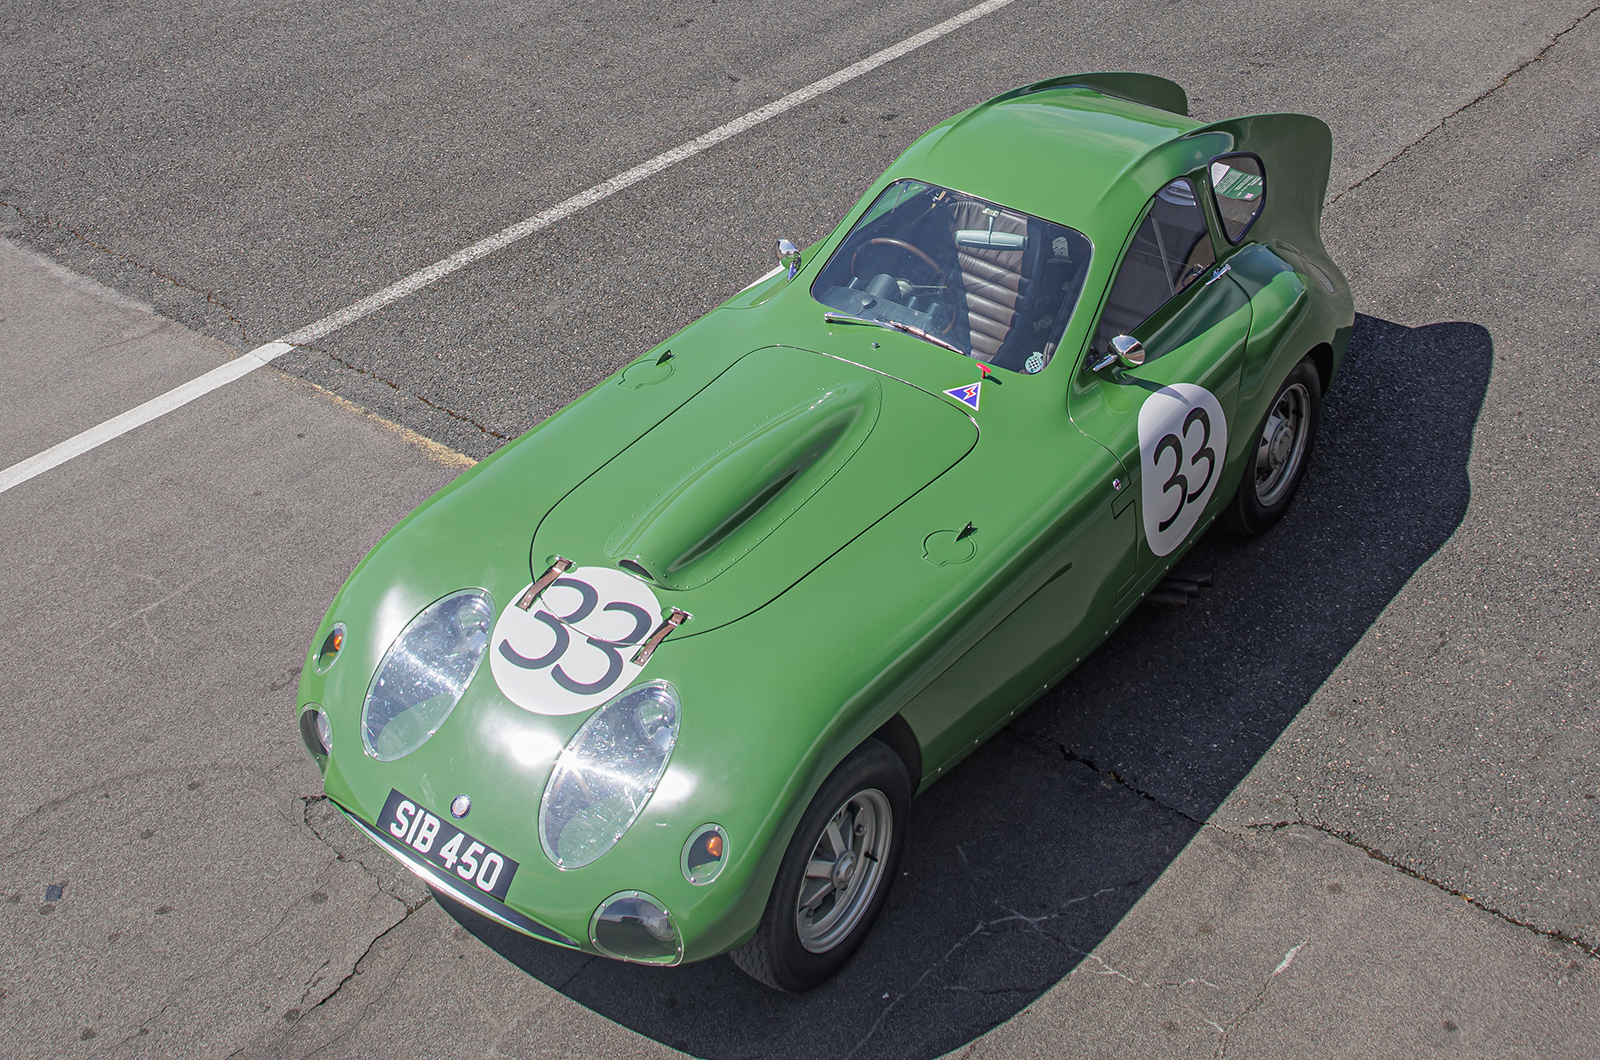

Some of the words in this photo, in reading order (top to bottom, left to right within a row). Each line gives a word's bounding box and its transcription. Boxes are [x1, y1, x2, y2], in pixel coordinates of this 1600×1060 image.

[1153, 406, 1216, 533] 33
[498, 577, 653, 696] 33
[390, 800, 441, 854] SIB
[439, 832, 504, 892] 450
